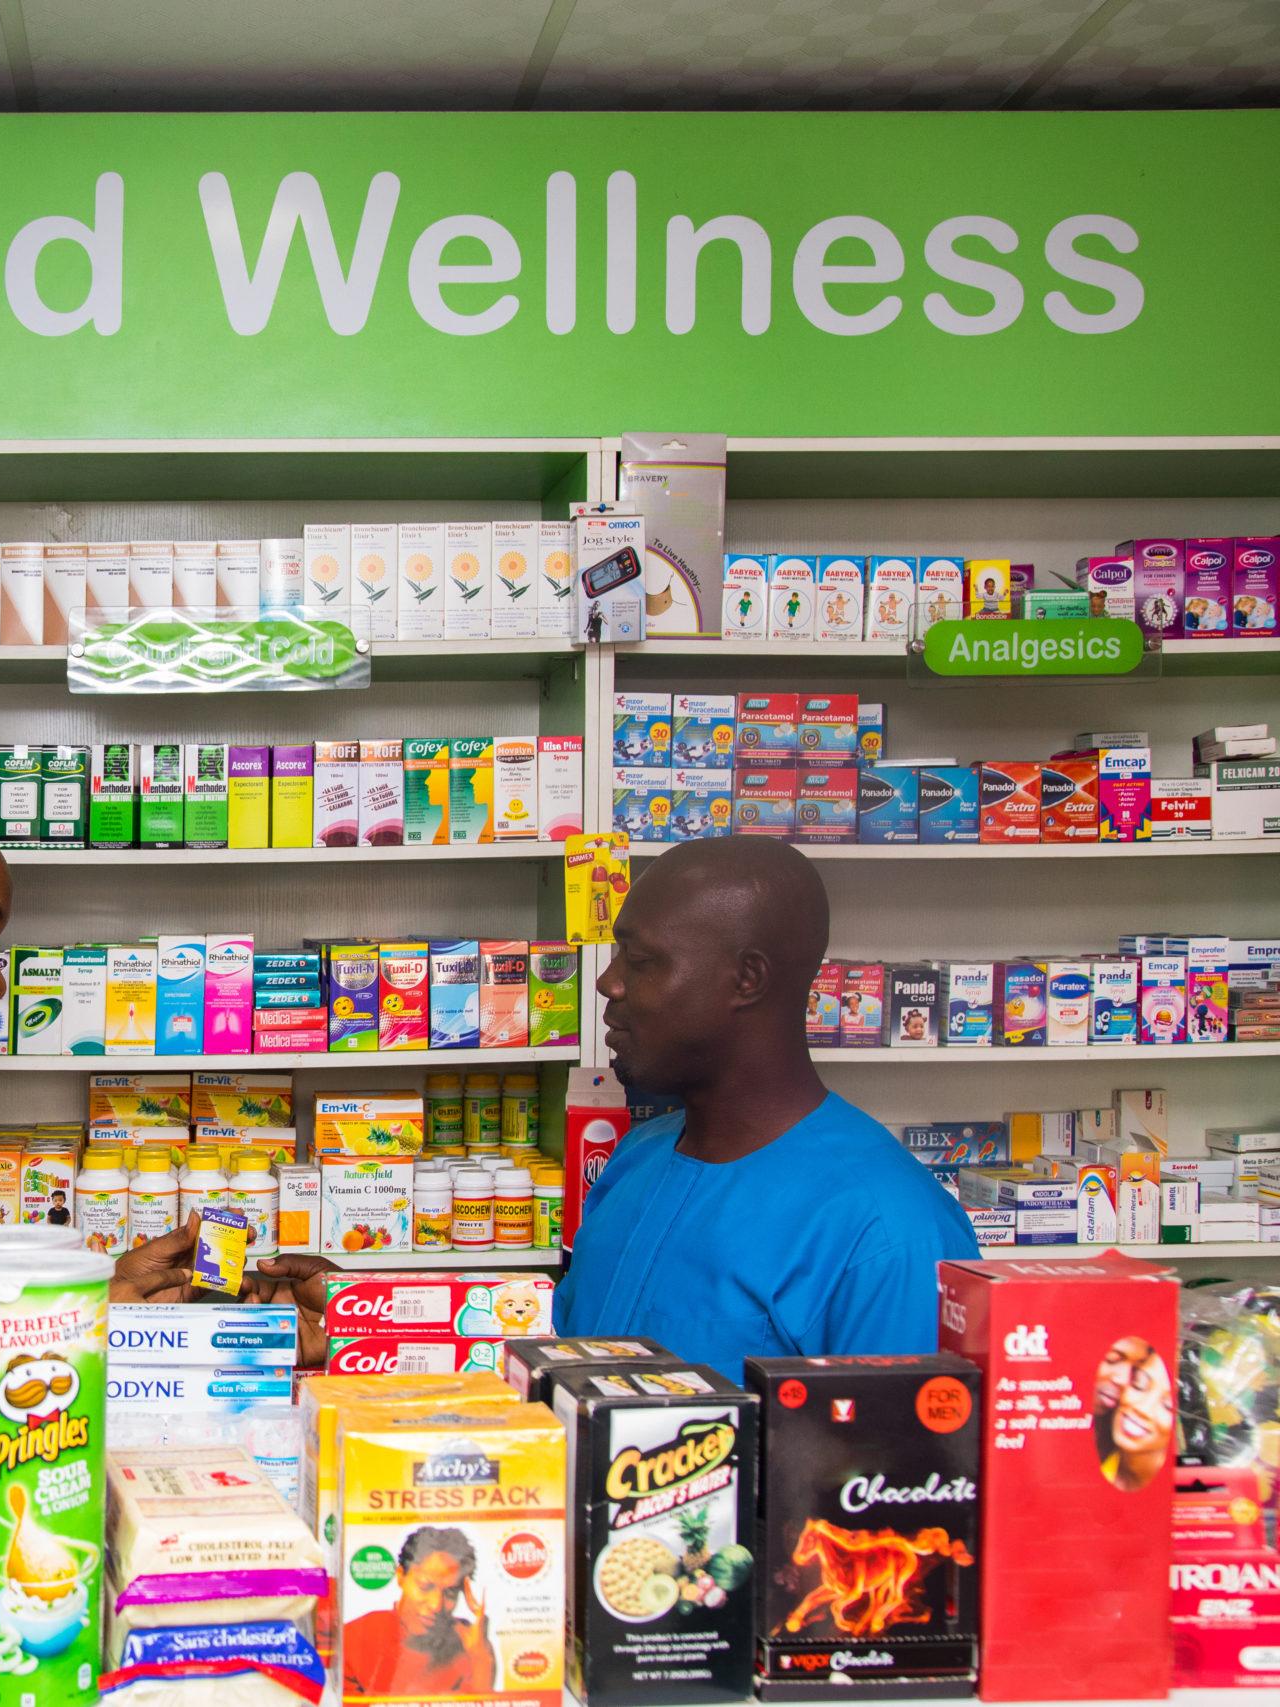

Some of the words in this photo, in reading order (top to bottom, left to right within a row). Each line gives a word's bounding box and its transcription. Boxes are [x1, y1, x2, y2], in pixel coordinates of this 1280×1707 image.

[198, 168, 1148, 338] Wellness
[495, 522, 533, 530] Bronchicum
[609, 521, 640, 529] OMRON
[583, 536, 602, 548] Jog
[605, 535, 634, 544] style
[653, 538, 664, 549] To
[663, 544, 679, 560] Live
[729, 568, 763, 577] BABYREX
[777, 569, 810, 577] BABYREX
[1092, 570, 1128, 581] Calpol
[271, 636, 334, 665] Cold
[949, 632, 1121, 667] Analgesics
[742, 713, 793, 721] Paracetamol
[653, 729, 667, 738] 30
[409, 743, 443, 754] Cofex
[232, 761, 263, 770] Ascorex
[1105, 757, 1146, 769] Emcap
[143, 776, 182, 794] Menthodex
[983, 783, 1014, 791] Panadol
[1004, 803, 1036, 811] Extra
[1161, 801, 1196, 810] Felvin
[568, 852, 593, 864] CARMEX
[1191, 947, 1225, 957] Emprofen
[114, 960, 152, 968] Rhinathiol
[22, 968, 61, 976] ASMALYN
[955, 974, 987, 984] panda
[894, 980, 935, 996] Panda
[1052, 982, 1086, 992] Paratex
[911, 994, 935, 1002] Cold
[260, 1035, 290, 1048] Medica
[321, 1103, 370, 1112] Em-Vit-C
[909, 1132, 952, 1146] IBEX
[344, 1169, 392, 1179] Naturesfield
[329, 1186, 363, 1195] Vitamin
[374, 1186, 406, 1196] 1000mg
[1035, 1190, 1058, 1198] INDOLAB
[207, 1214, 243, 1227] Actifed
[1088, 1198, 1096, 1241] Cataflam
[1, 1310, 81, 1332] PERFECT
[217, 1335, 238, 1344] Extra
[240, 1335, 262, 1344] Fresh
[927, 1390, 960, 1403] FOR
[927, 1405, 962, 1419] MEN
[607, 1425, 735, 1499] Cracker
[37, 1460, 88, 1485] SOUR
[417, 1460, 491, 1478] Archy's
[35, 1476, 91, 1504] CREAM
[841, 1474, 976, 1512] Chocolate
[369, 1490, 462, 1509] STRESS
[474, 1487, 539, 1506] PACK
